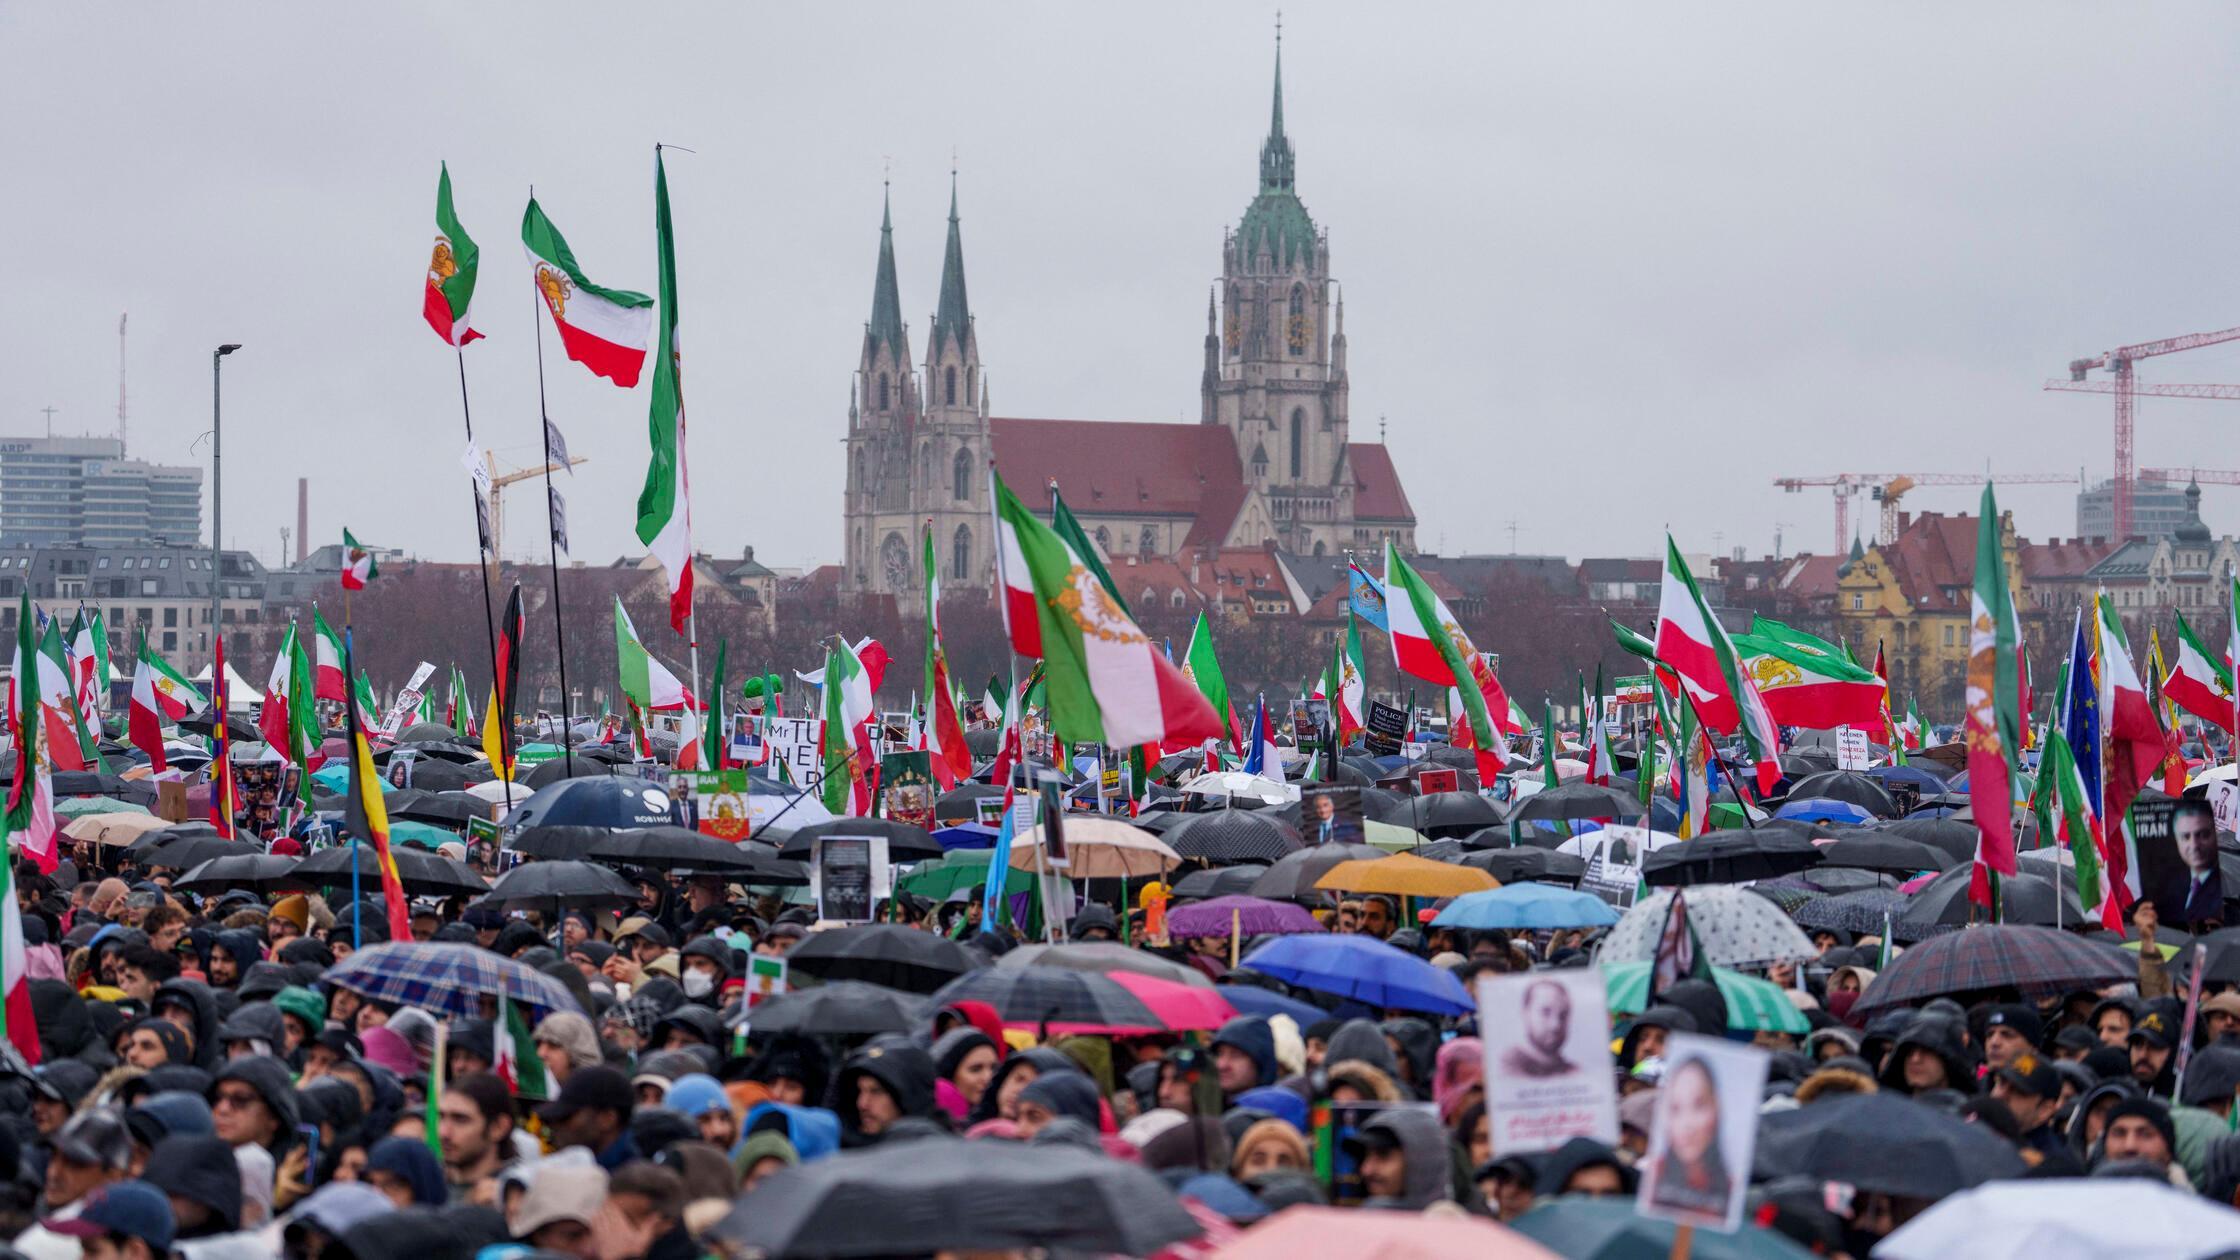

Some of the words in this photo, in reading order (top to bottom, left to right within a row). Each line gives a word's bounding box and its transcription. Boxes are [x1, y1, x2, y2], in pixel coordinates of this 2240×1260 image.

[0, 443, 25, 453] ARD
[770, 724, 788, 738] Mr
[699, 775, 719, 784] IRAN
[2136, 822, 2169, 838] IRAN
